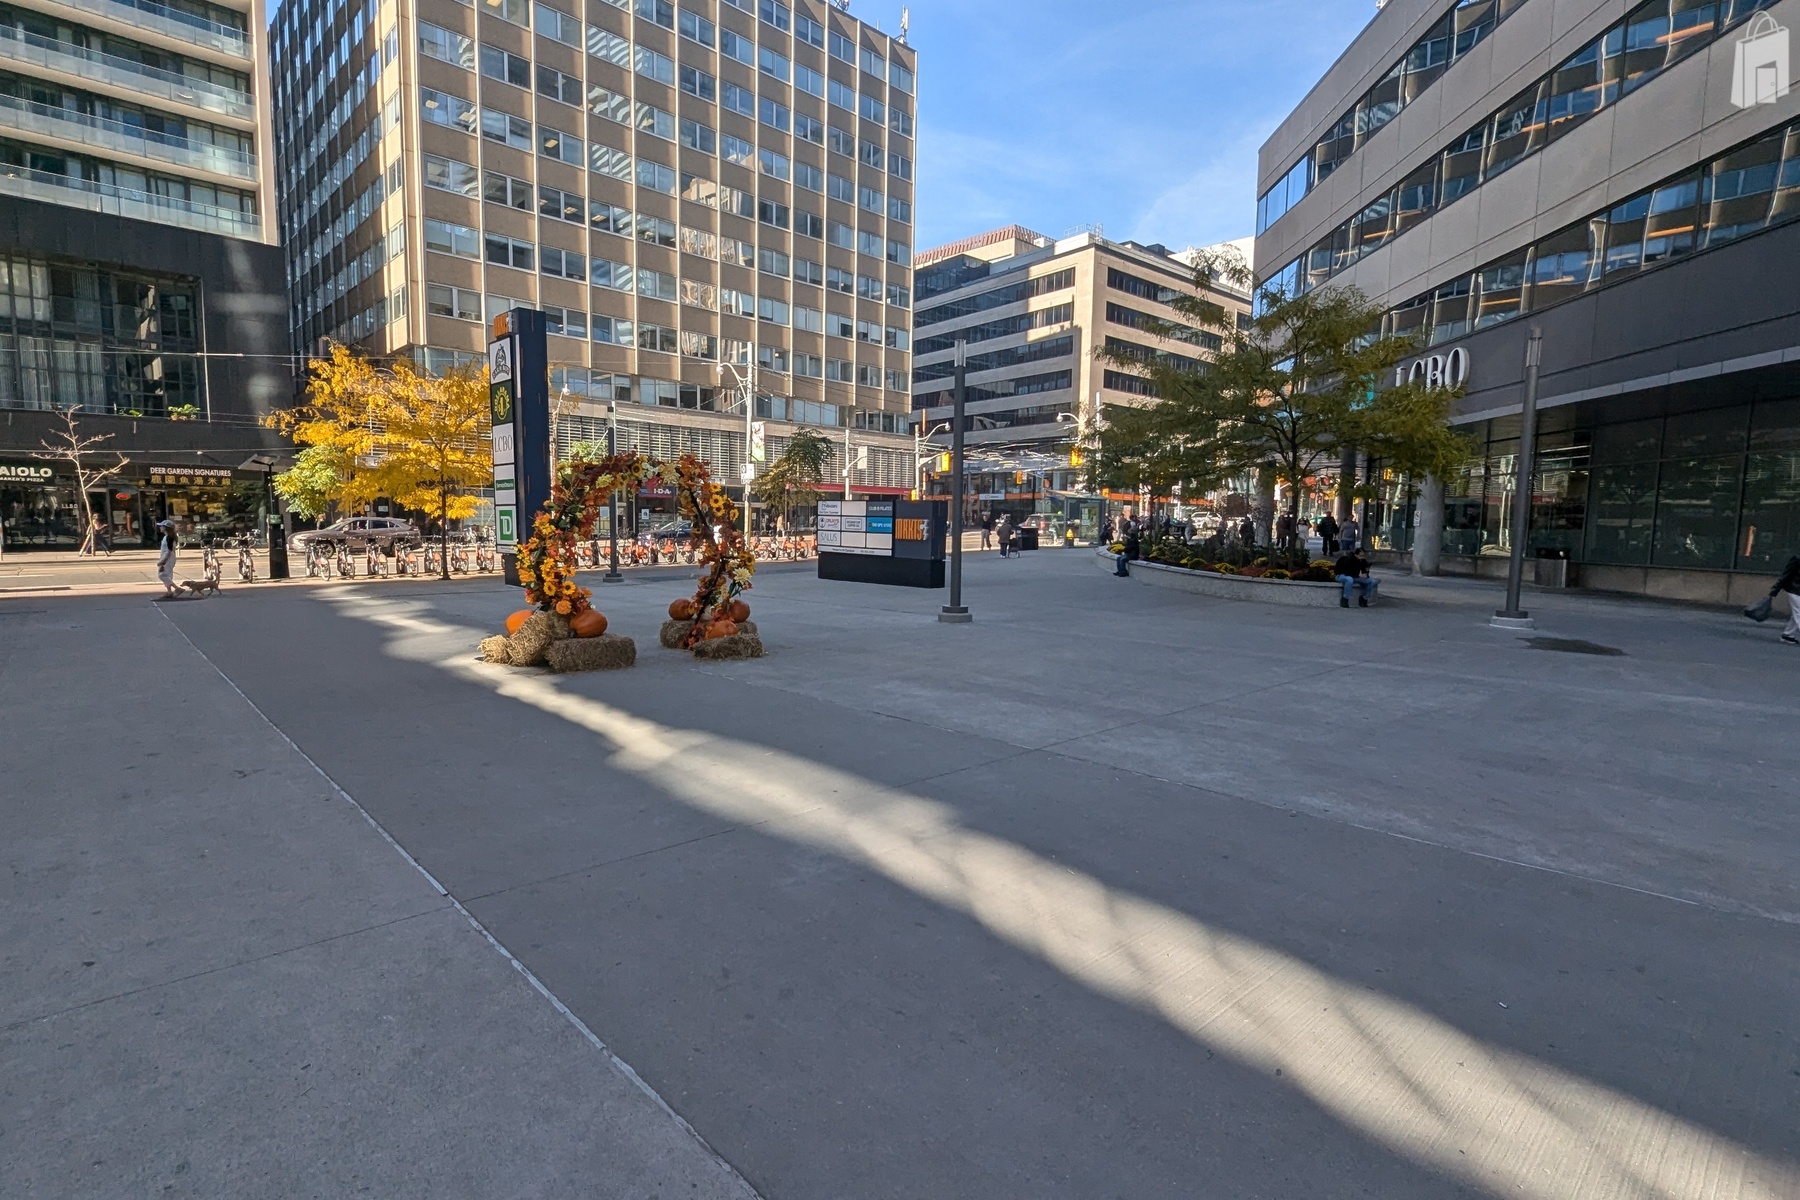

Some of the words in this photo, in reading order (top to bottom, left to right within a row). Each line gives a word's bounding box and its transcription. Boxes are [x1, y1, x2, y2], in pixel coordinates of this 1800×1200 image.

[494, 435, 512, 453] LCBO
[0, 466, 53, 478] AIOLO
[150, 467, 166, 475] DEER
[167, 467, 194, 476] GARDEN
[194, 469, 232, 477] SIGNATURES
[501, 515, 512, 535] TD
[820, 532, 838, 541] SALUS
